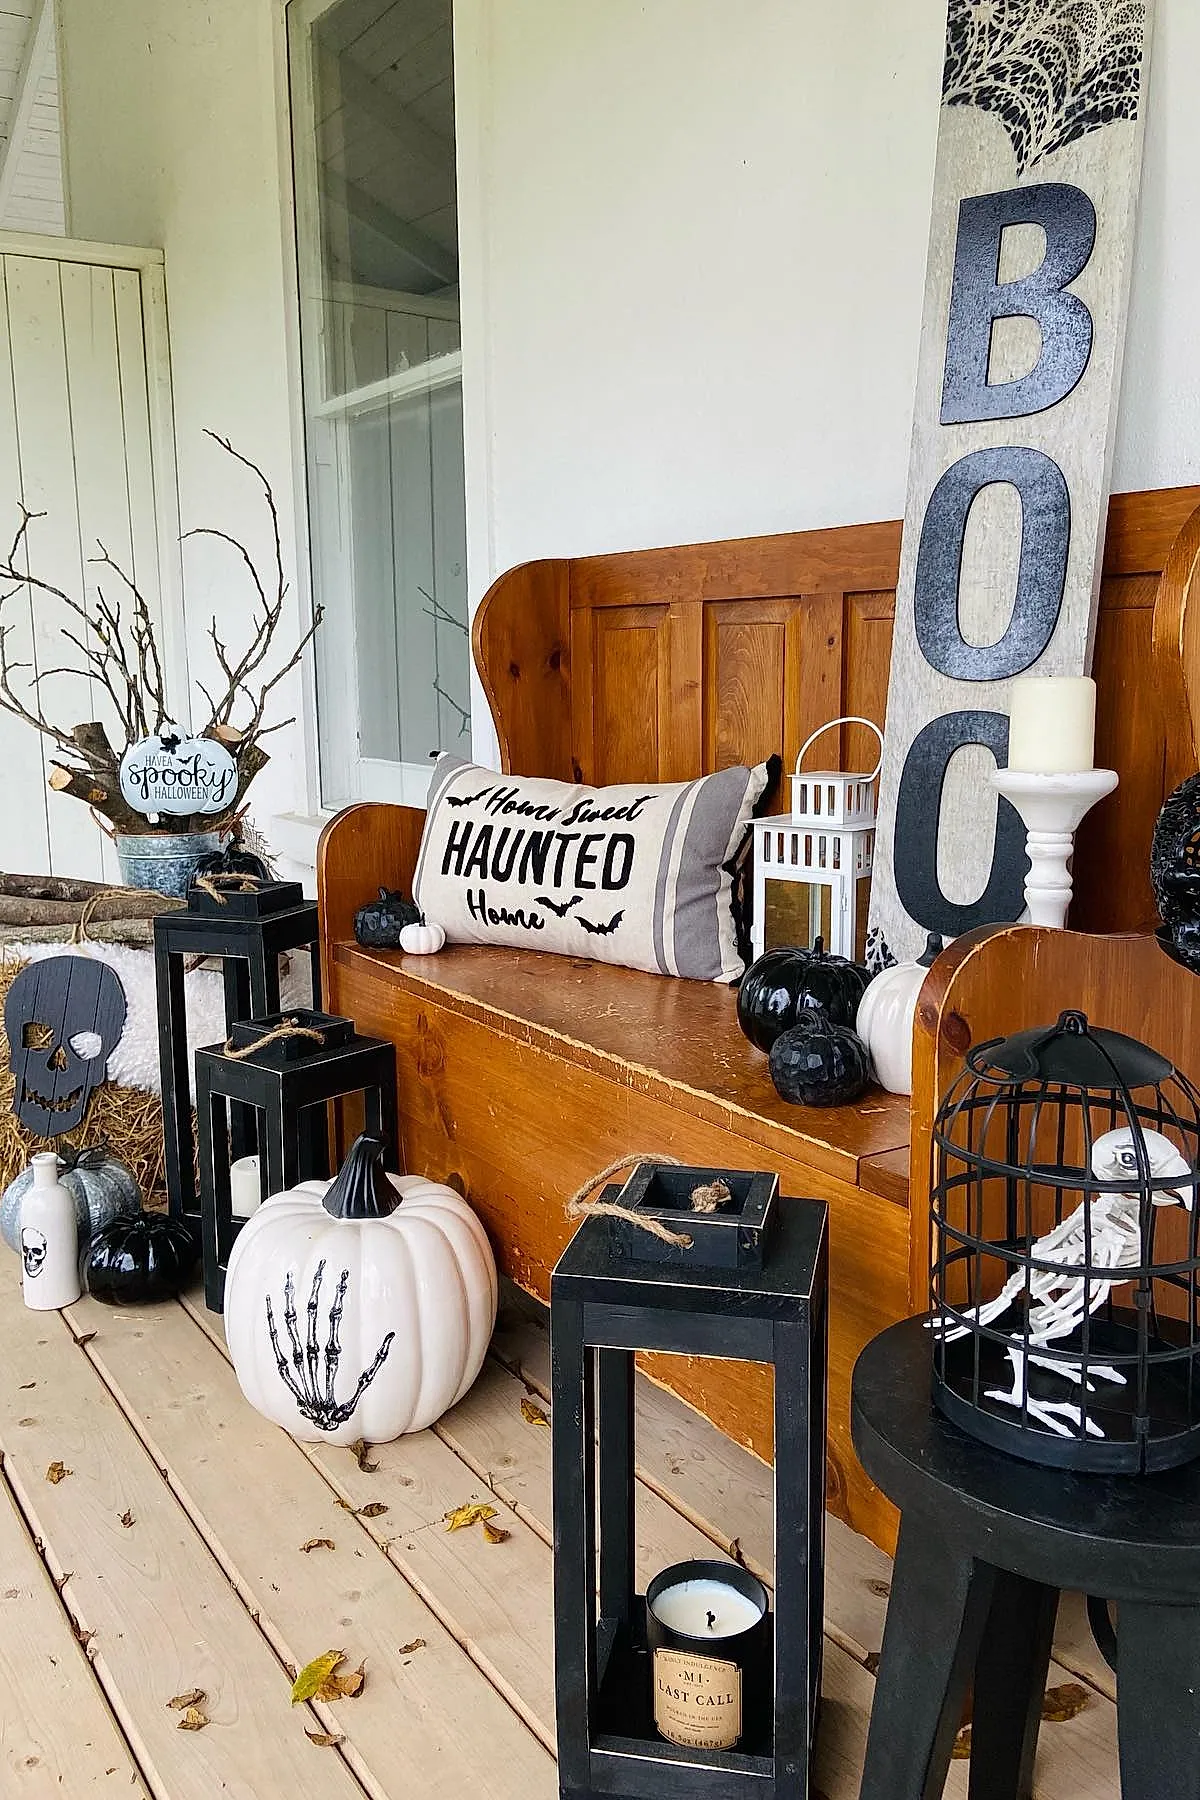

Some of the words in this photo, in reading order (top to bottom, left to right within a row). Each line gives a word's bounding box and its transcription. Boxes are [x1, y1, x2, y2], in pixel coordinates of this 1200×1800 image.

[894, 182, 1096, 938] BOO
[128, 753, 234, 803] spooky
[154, 786, 209, 800] HALLOWEEN
[485, 786, 562, 822] Home
[561, 795, 660, 826] Sweet
[441, 820, 635, 890] HAUNTED
[466, 888, 545, 930] Home
[658, 1678, 689, 1702] LAST
[696, 1693, 734, 1706] CALL
